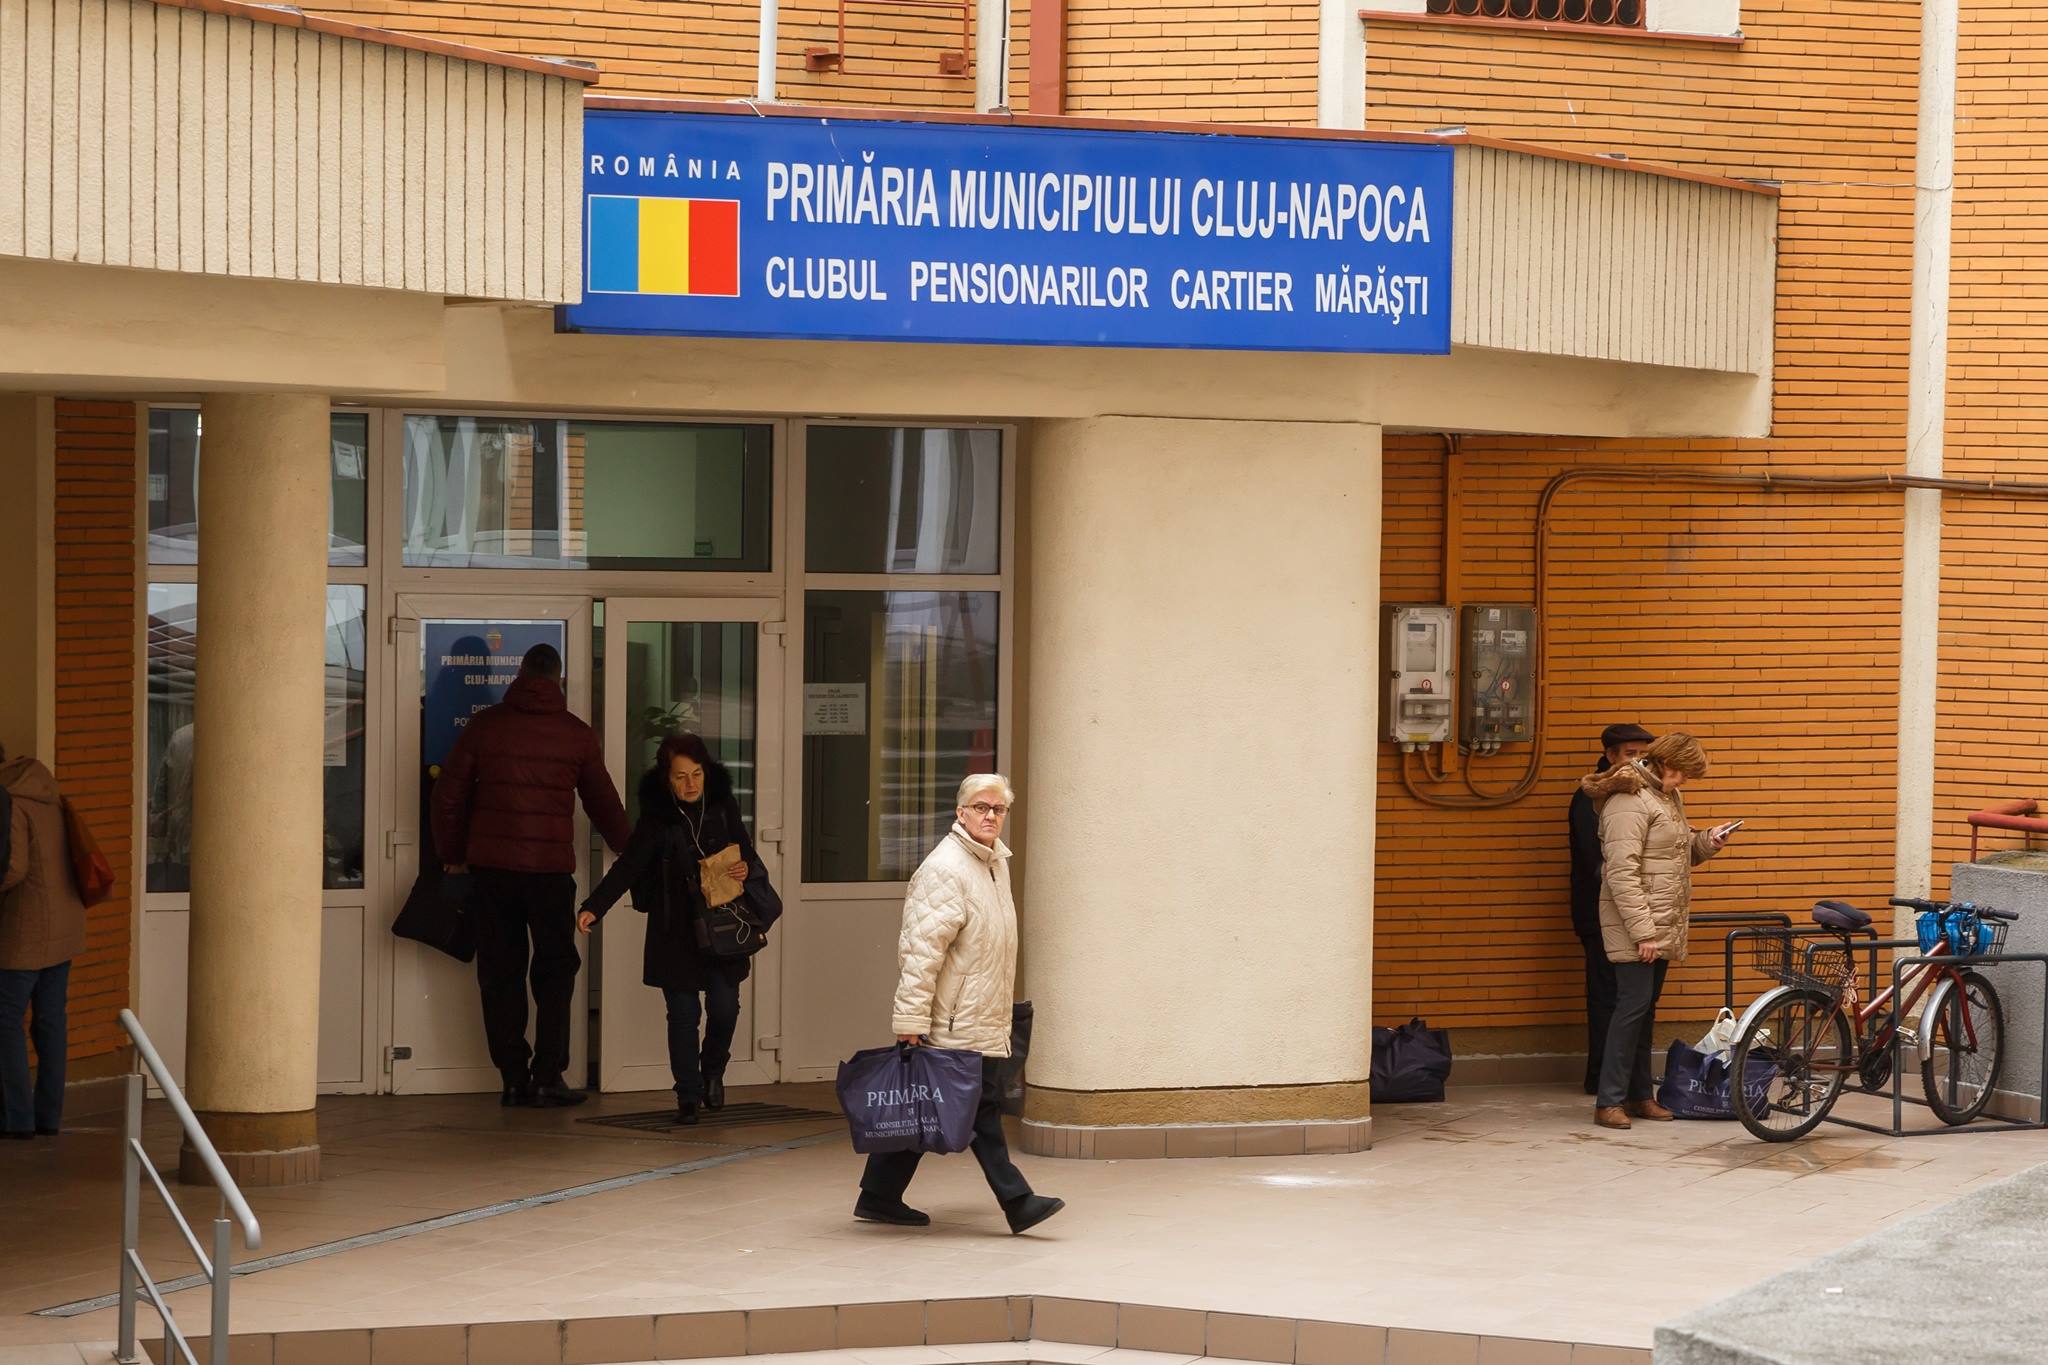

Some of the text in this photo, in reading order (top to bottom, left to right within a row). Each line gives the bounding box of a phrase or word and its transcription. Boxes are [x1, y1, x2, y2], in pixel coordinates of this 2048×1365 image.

[590, 153, 741, 181] ROMÂNIA
[766, 150, 1431, 243] PRIMĂRIA MUNICIPIULUI CLUJ-NAPOCA
[765, 255, 888, 301] CLUBUL
[910, 260, 1150, 308] PENSIONARILOR
[1170, 268, 1294, 312] CARTIER
